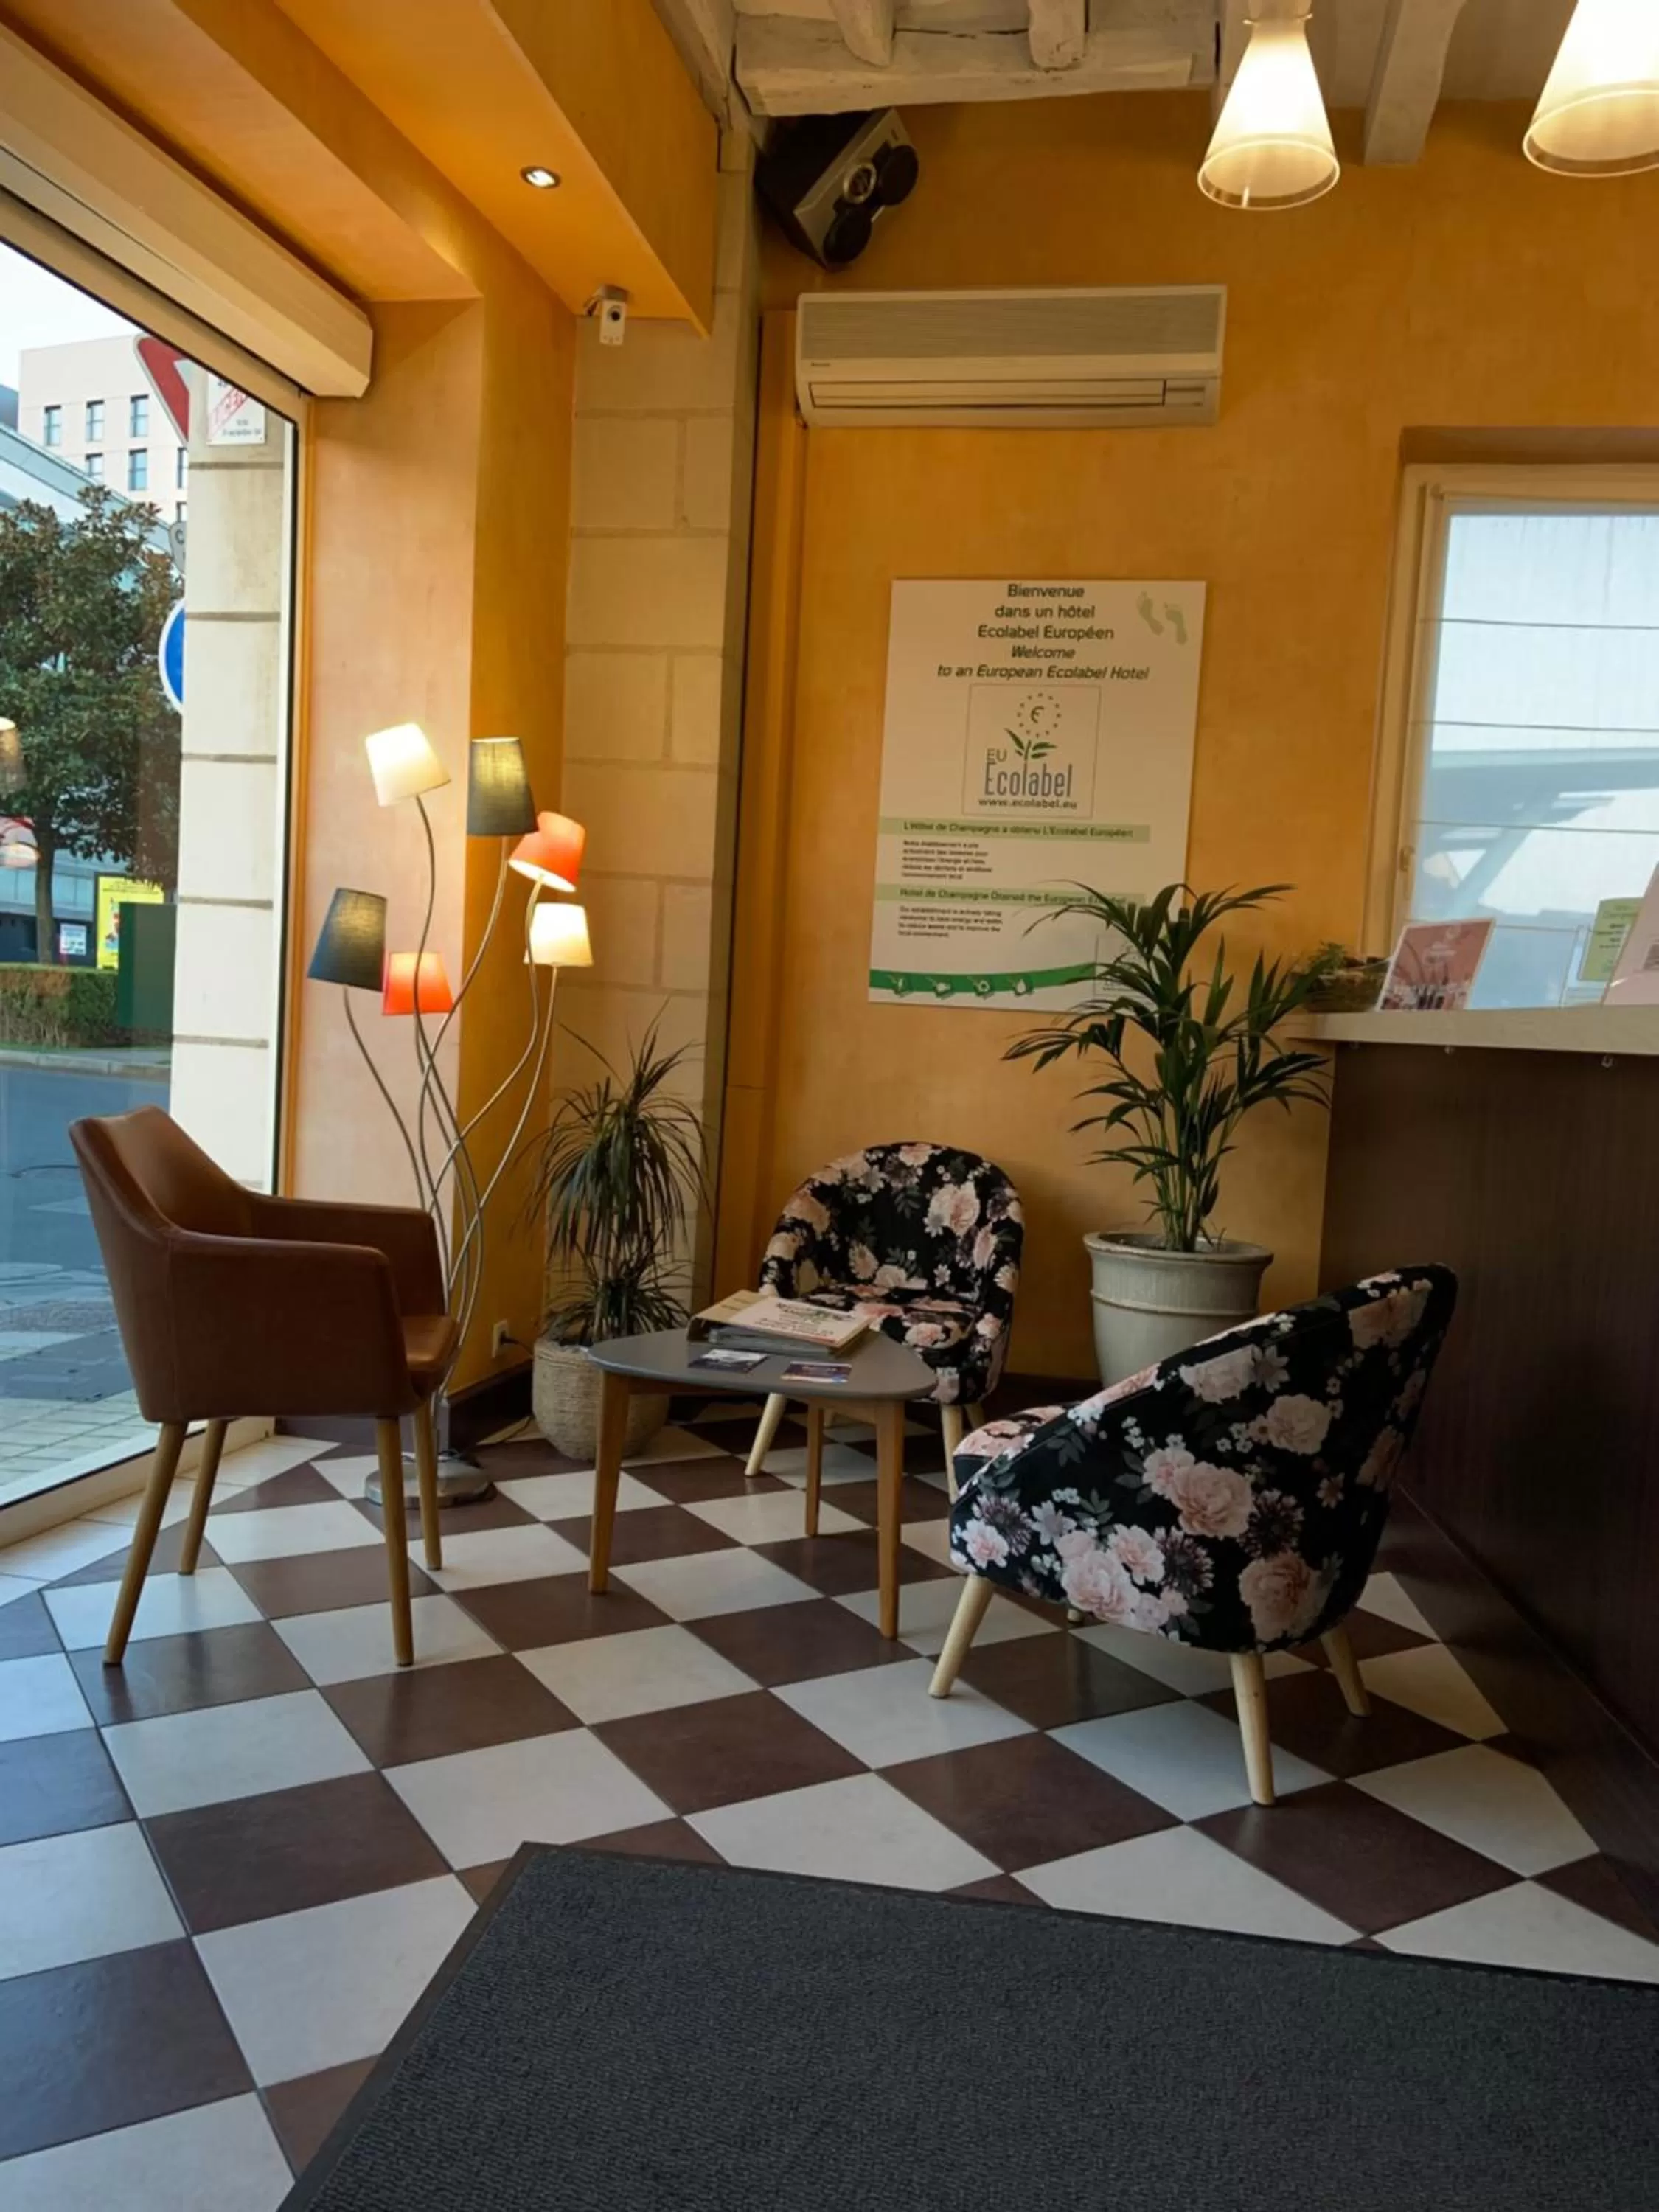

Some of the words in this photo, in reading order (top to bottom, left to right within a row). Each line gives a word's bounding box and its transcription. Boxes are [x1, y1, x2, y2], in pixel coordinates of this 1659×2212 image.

[1007, 584, 1085, 597] Bienvenue
[995, 605, 1030, 618] dans
[1035, 608, 1053, 618] un
[1058, 605, 1096, 618] hôtel
[978, 625, 1039, 638] Ecolabel
[1044, 625, 1114, 642] Européen
[1011, 645, 1076, 658] Welcome
[937, 665, 952, 677] to
[956, 667, 973, 677] an
[976, 664, 1043, 680] European
[1047, 665, 1107, 679] Ecolabel
[1110, 666, 1150, 679] Hotel
[987, 748, 1007, 762] EU
[984, 762, 1073, 797] Ecolabel
[978, 799, 1077, 809] www.ecolabel.eu
